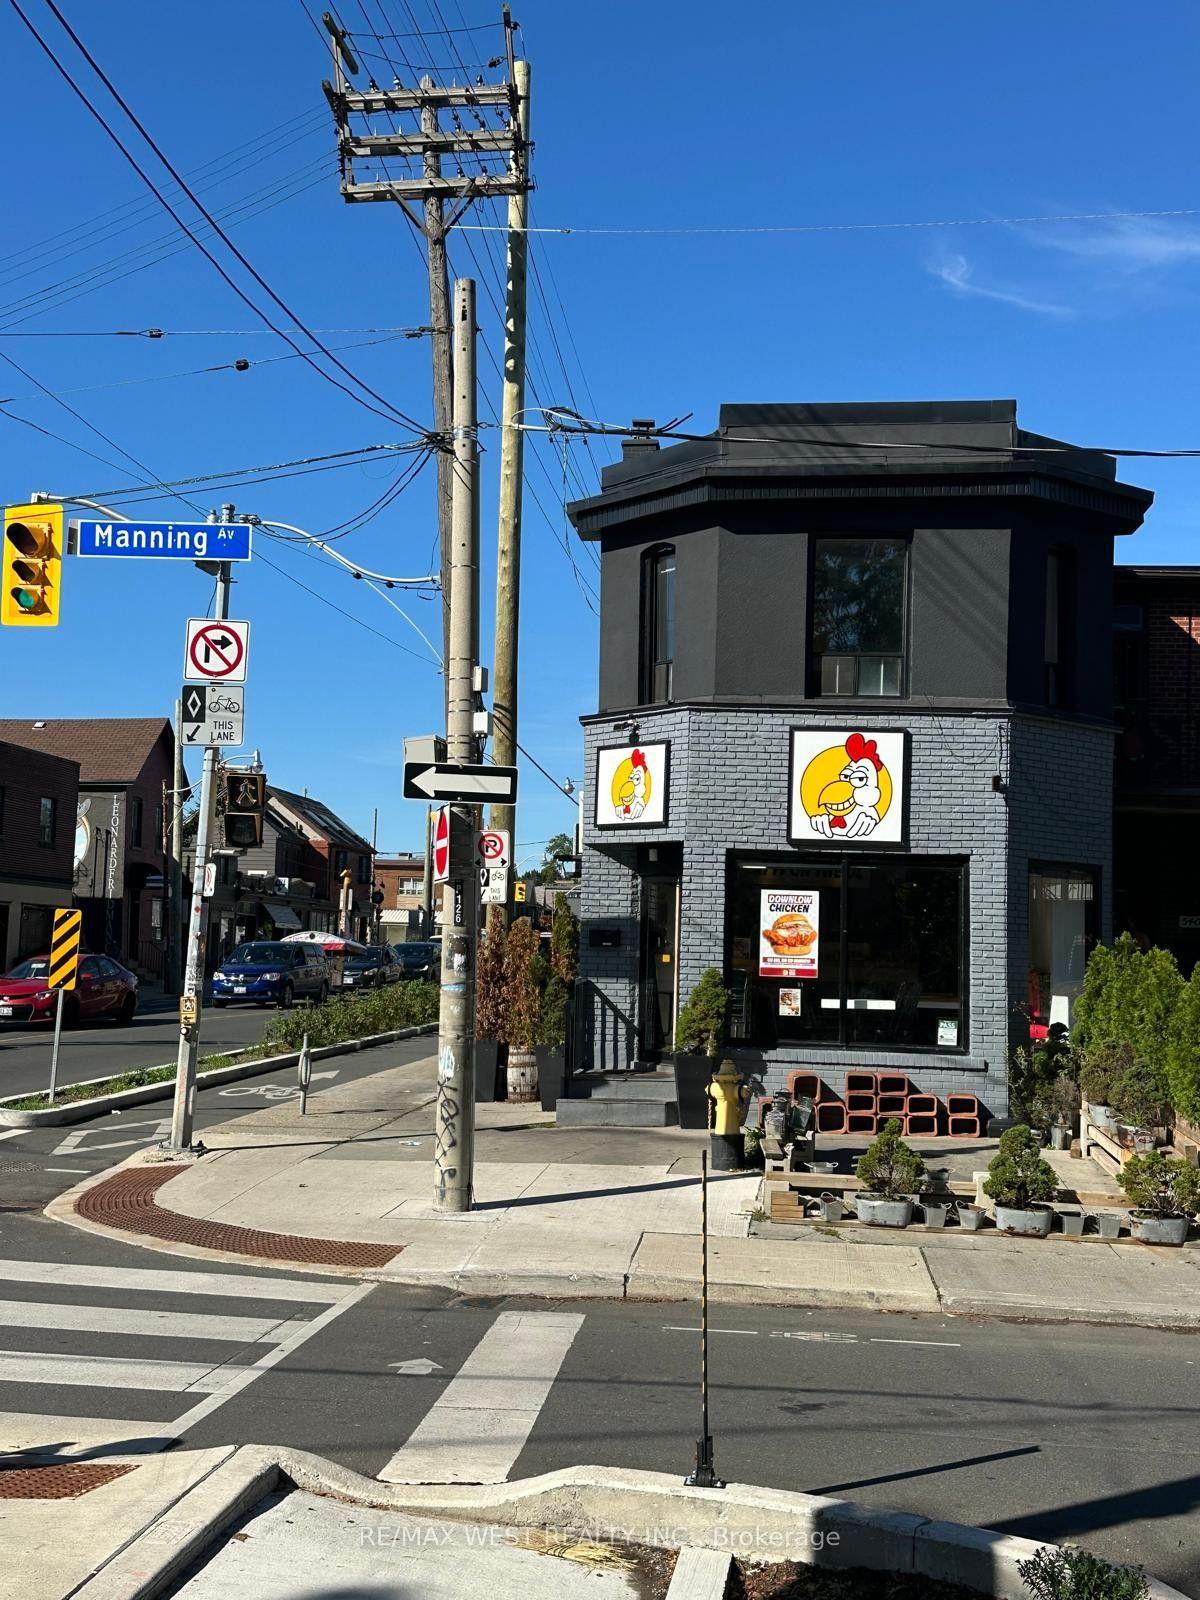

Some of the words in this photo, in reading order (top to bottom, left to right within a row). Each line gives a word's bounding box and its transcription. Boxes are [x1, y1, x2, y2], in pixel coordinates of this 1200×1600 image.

[94, 523, 208, 557] Manning
[217, 527, 235, 540] Av
[213, 720, 234, 730] THIS
[210, 731, 235, 741] LANE
[768, 894, 813, 904] DOWNLOW
[769, 903, 810, 913] CHICKEN
